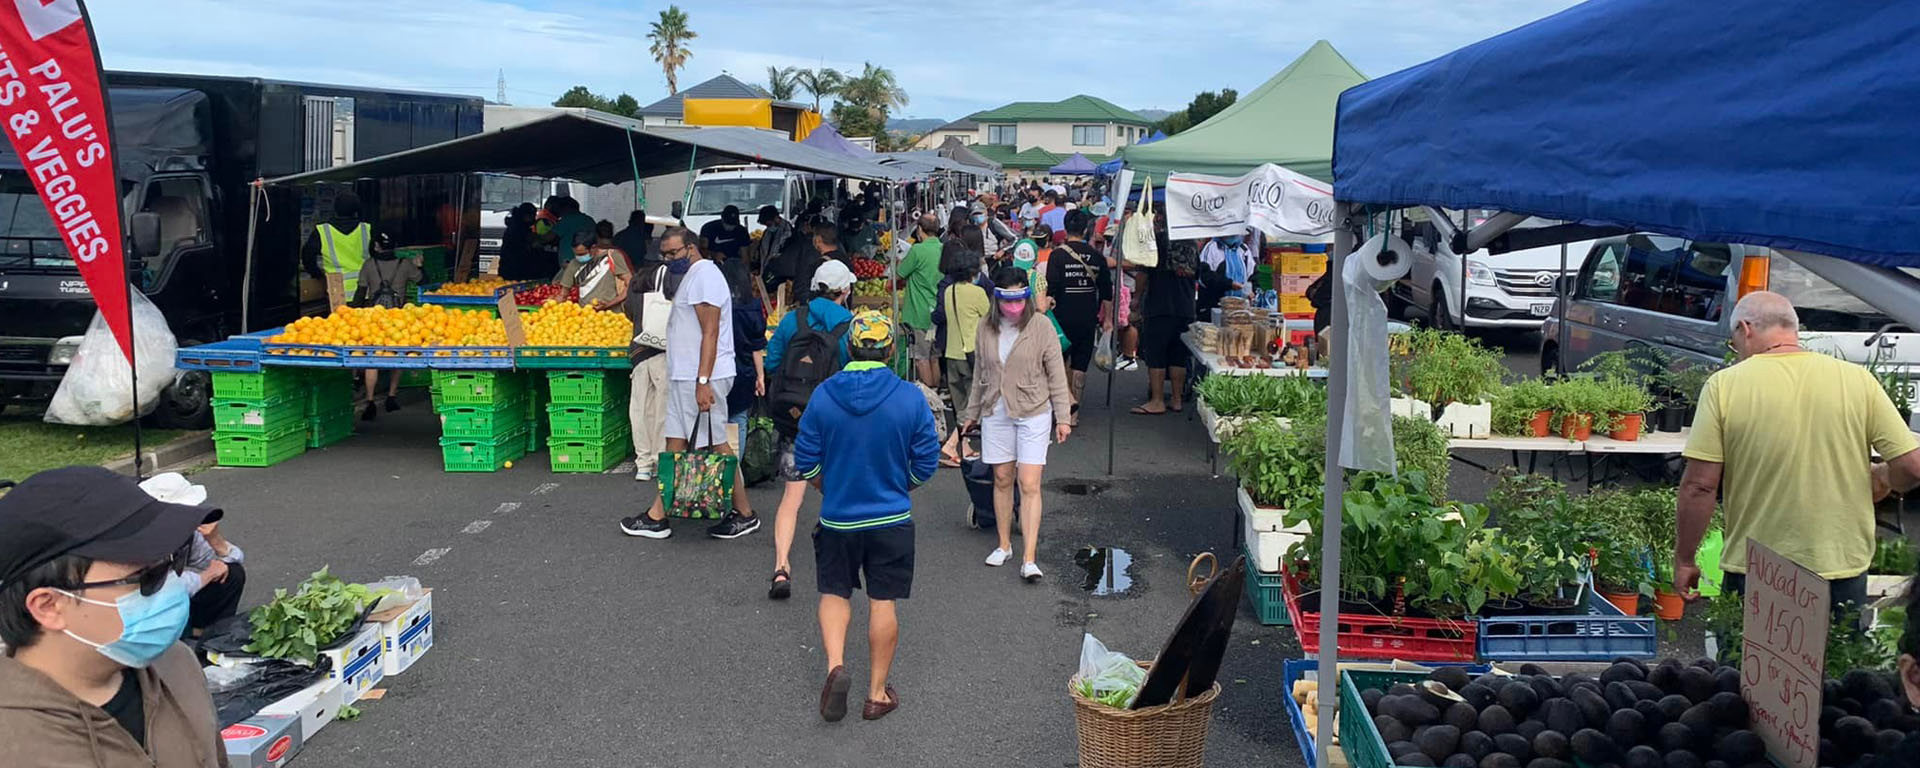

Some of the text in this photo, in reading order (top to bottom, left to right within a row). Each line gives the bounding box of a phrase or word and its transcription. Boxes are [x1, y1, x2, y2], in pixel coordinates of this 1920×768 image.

[29, 58, 105, 168] PALU'S
[9, 109, 40, 139] &
[26, 135, 109, 263] VEGGIES
[1744, 641, 1761, 686] 5
